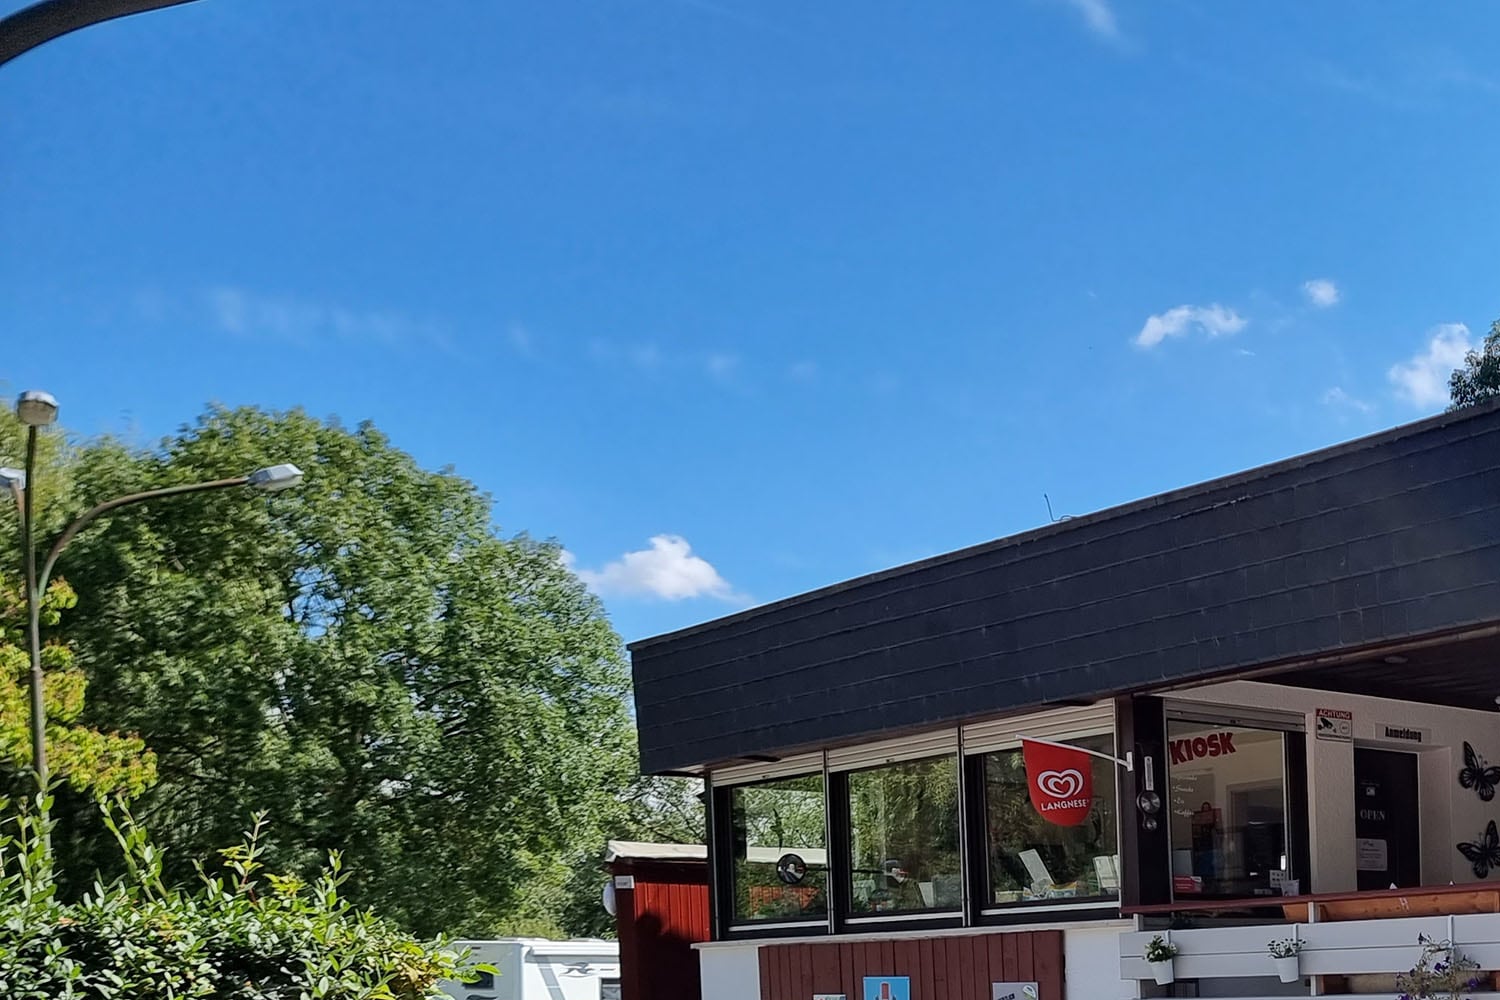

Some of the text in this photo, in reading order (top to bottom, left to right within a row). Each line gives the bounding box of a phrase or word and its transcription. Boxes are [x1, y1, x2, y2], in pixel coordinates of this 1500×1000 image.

[1318, 708, 1351, 720] ACHTUNG
[1384, 726, 1422, 742] Anmeldung
[1169, 732, 1236, 766] KIOSK
[1040, 799, 1087, 811] LANGNESE
[1360, 809, 1385, 820] OPEN
